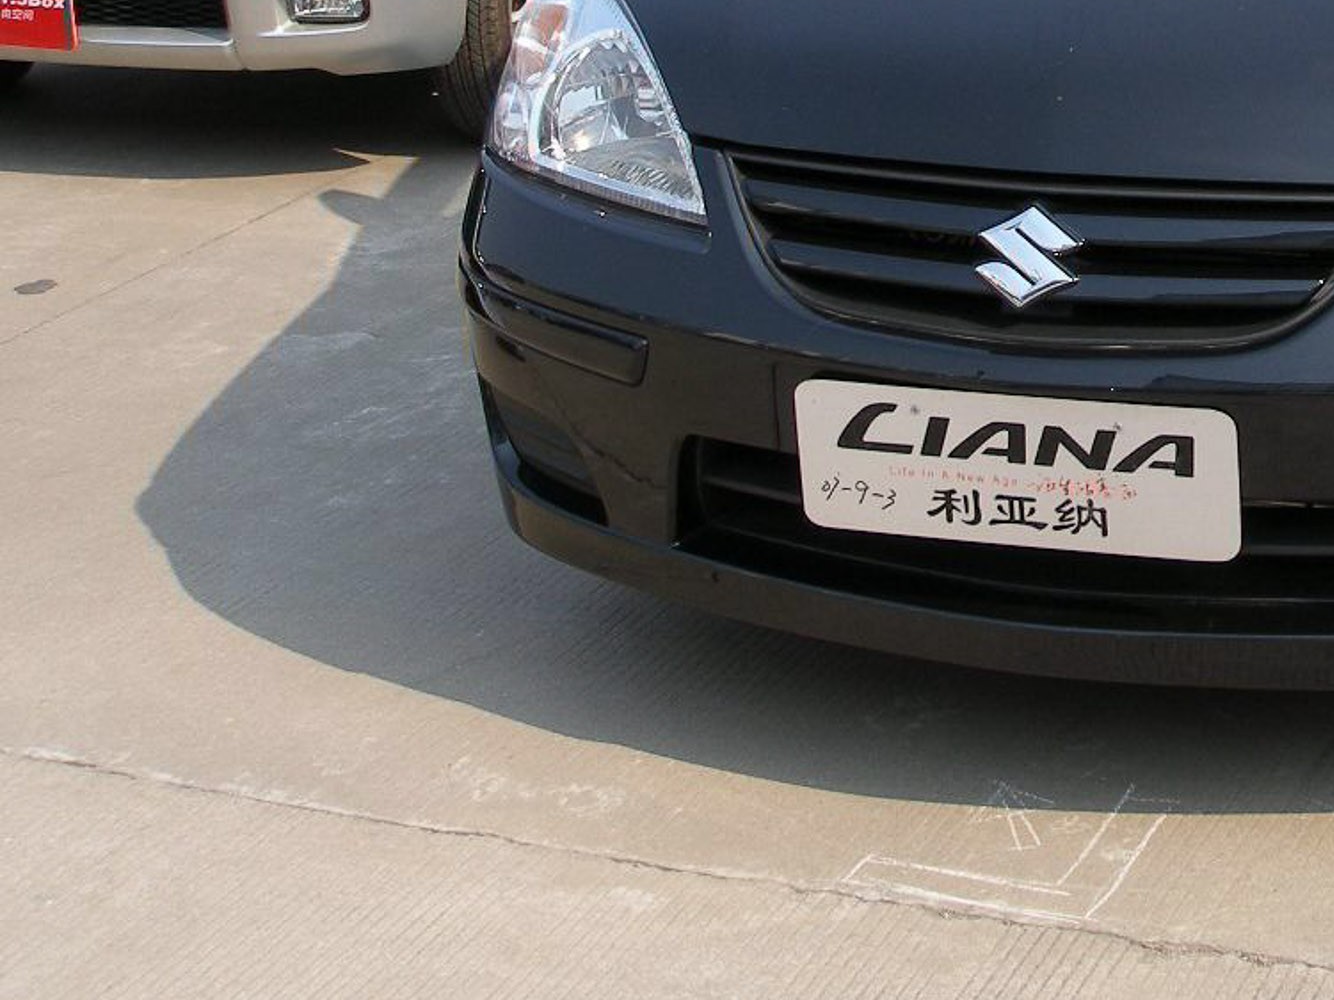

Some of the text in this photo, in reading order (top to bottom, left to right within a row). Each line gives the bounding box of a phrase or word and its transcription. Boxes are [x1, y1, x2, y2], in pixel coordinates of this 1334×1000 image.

[837, 402, 1195, 477] LIANA
[926, 488, 1109, 538] 利亚纳
